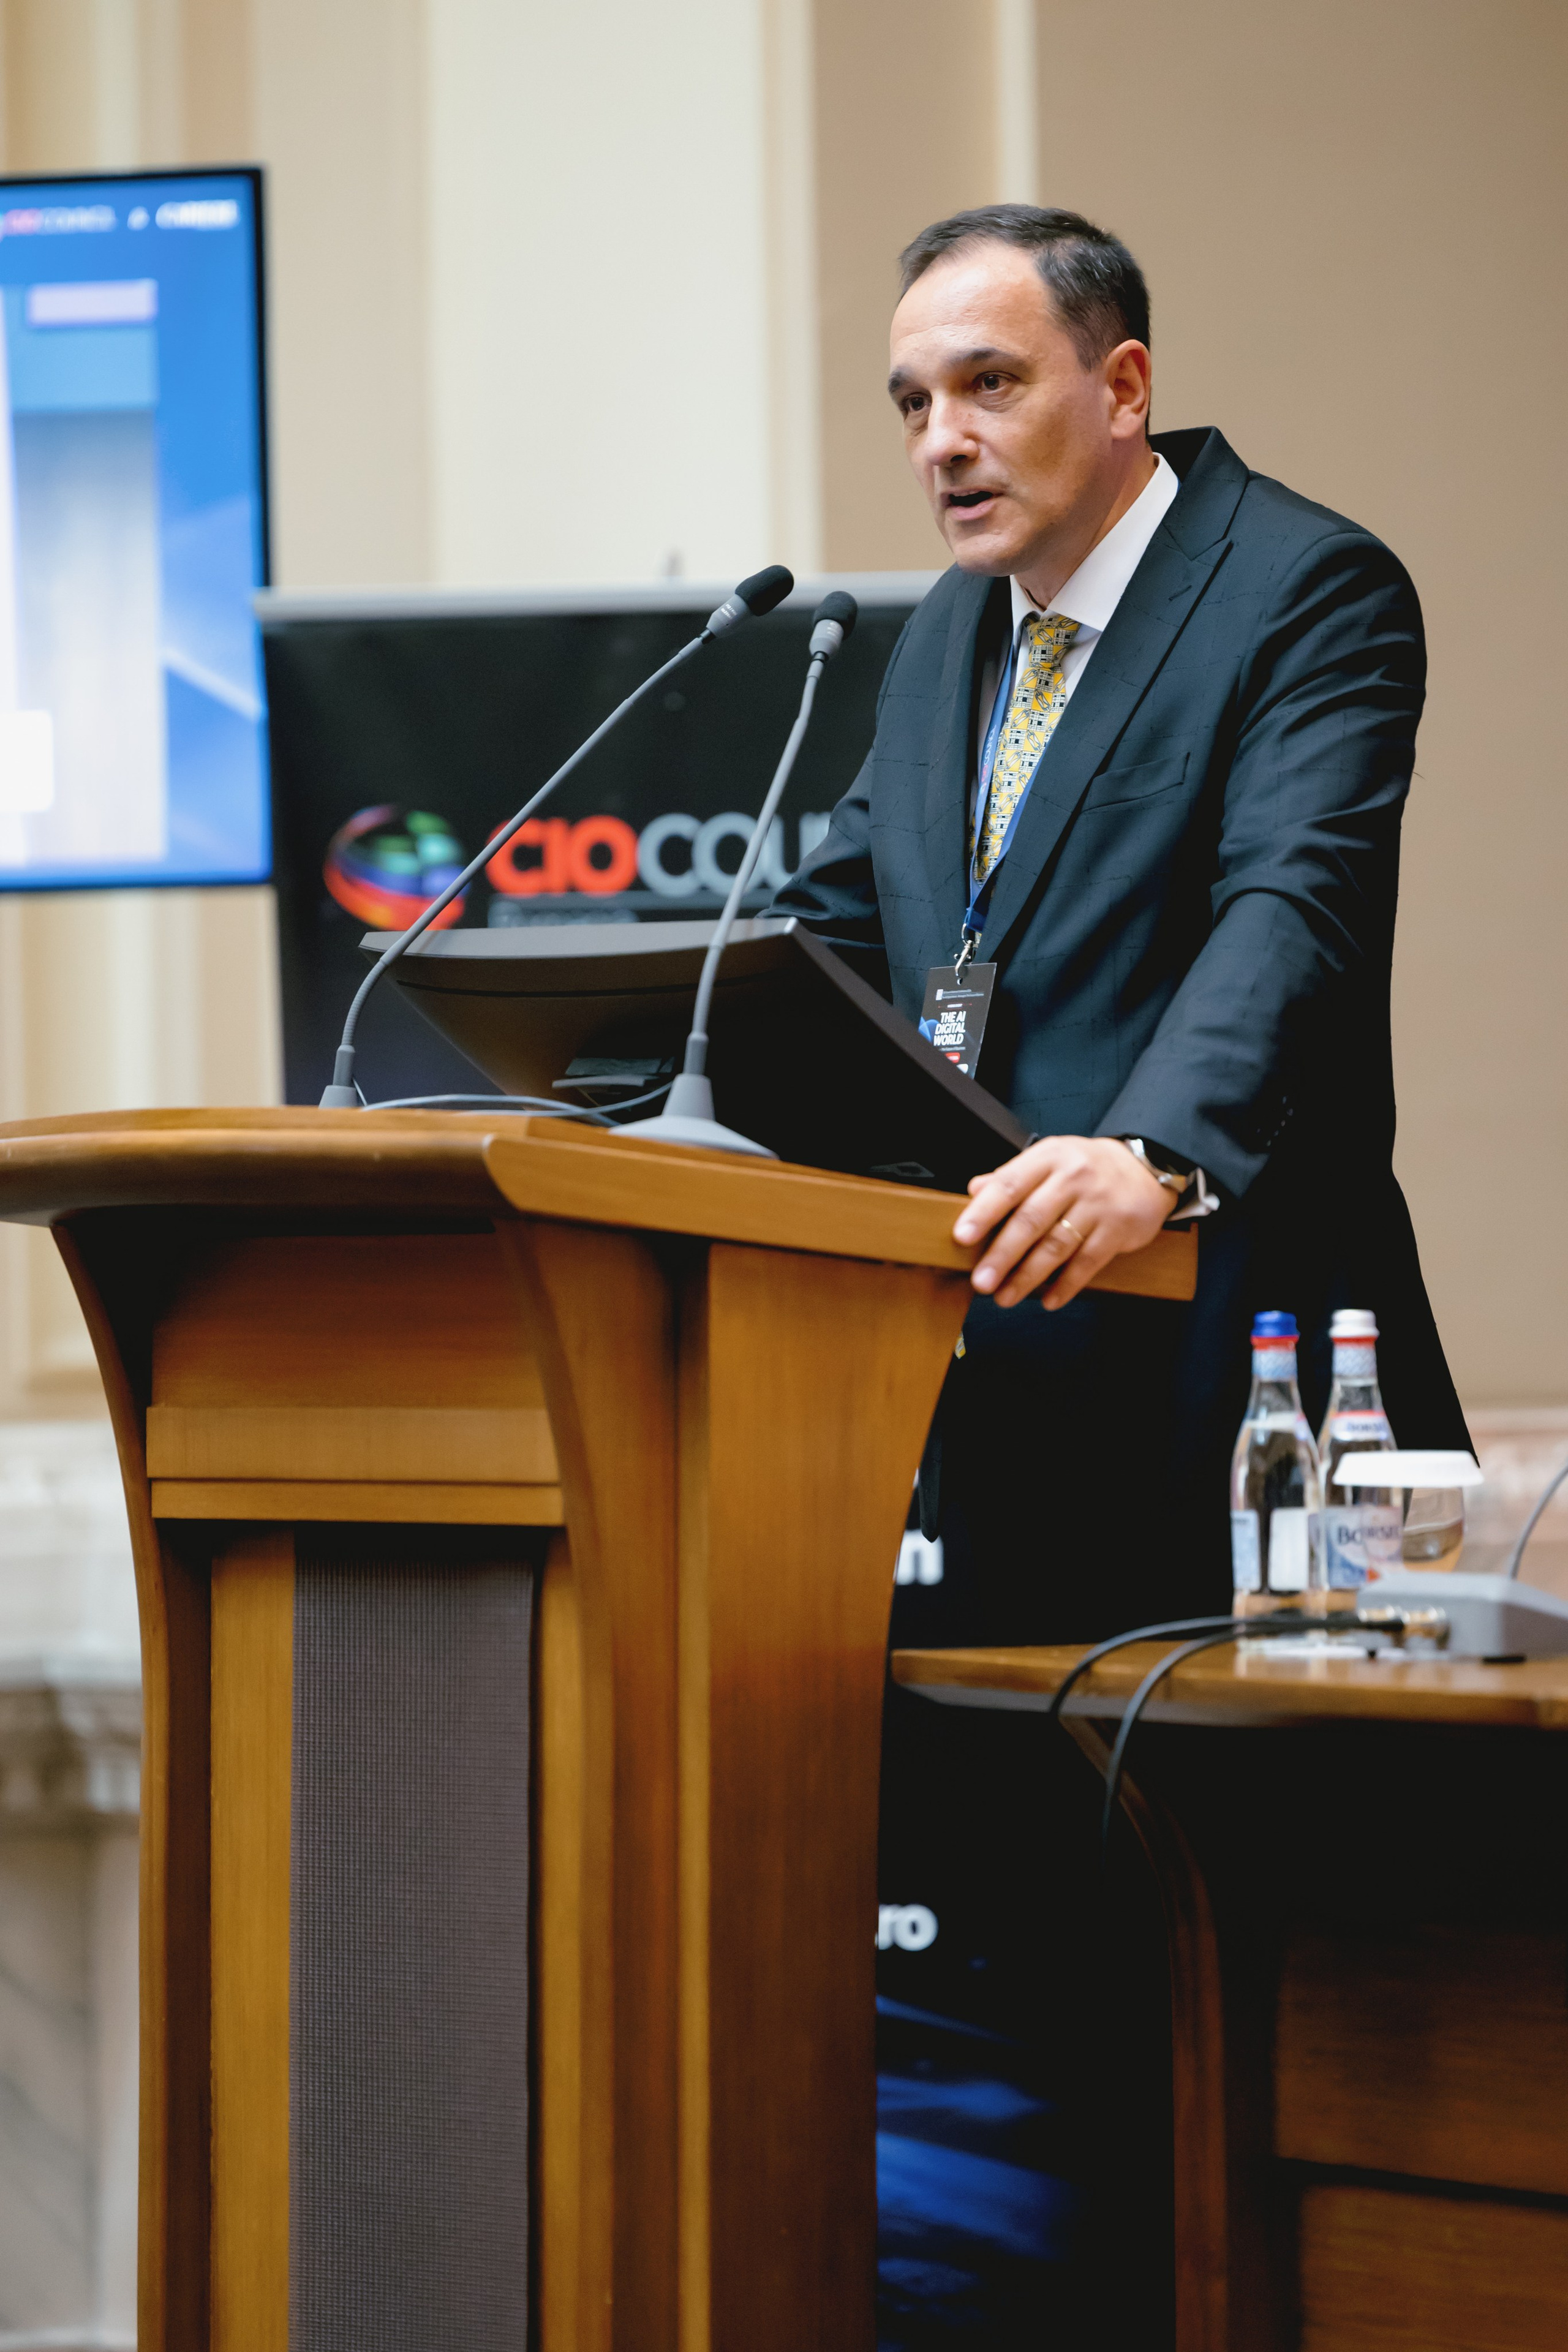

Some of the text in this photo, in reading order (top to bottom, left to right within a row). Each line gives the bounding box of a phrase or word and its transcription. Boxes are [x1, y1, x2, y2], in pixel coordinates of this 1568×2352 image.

[941, 1011, 966, 1023] THE AI
[935, 1022, 965, 1035] DIGITAL
[933, 1033, 963, 1046] WORLD
